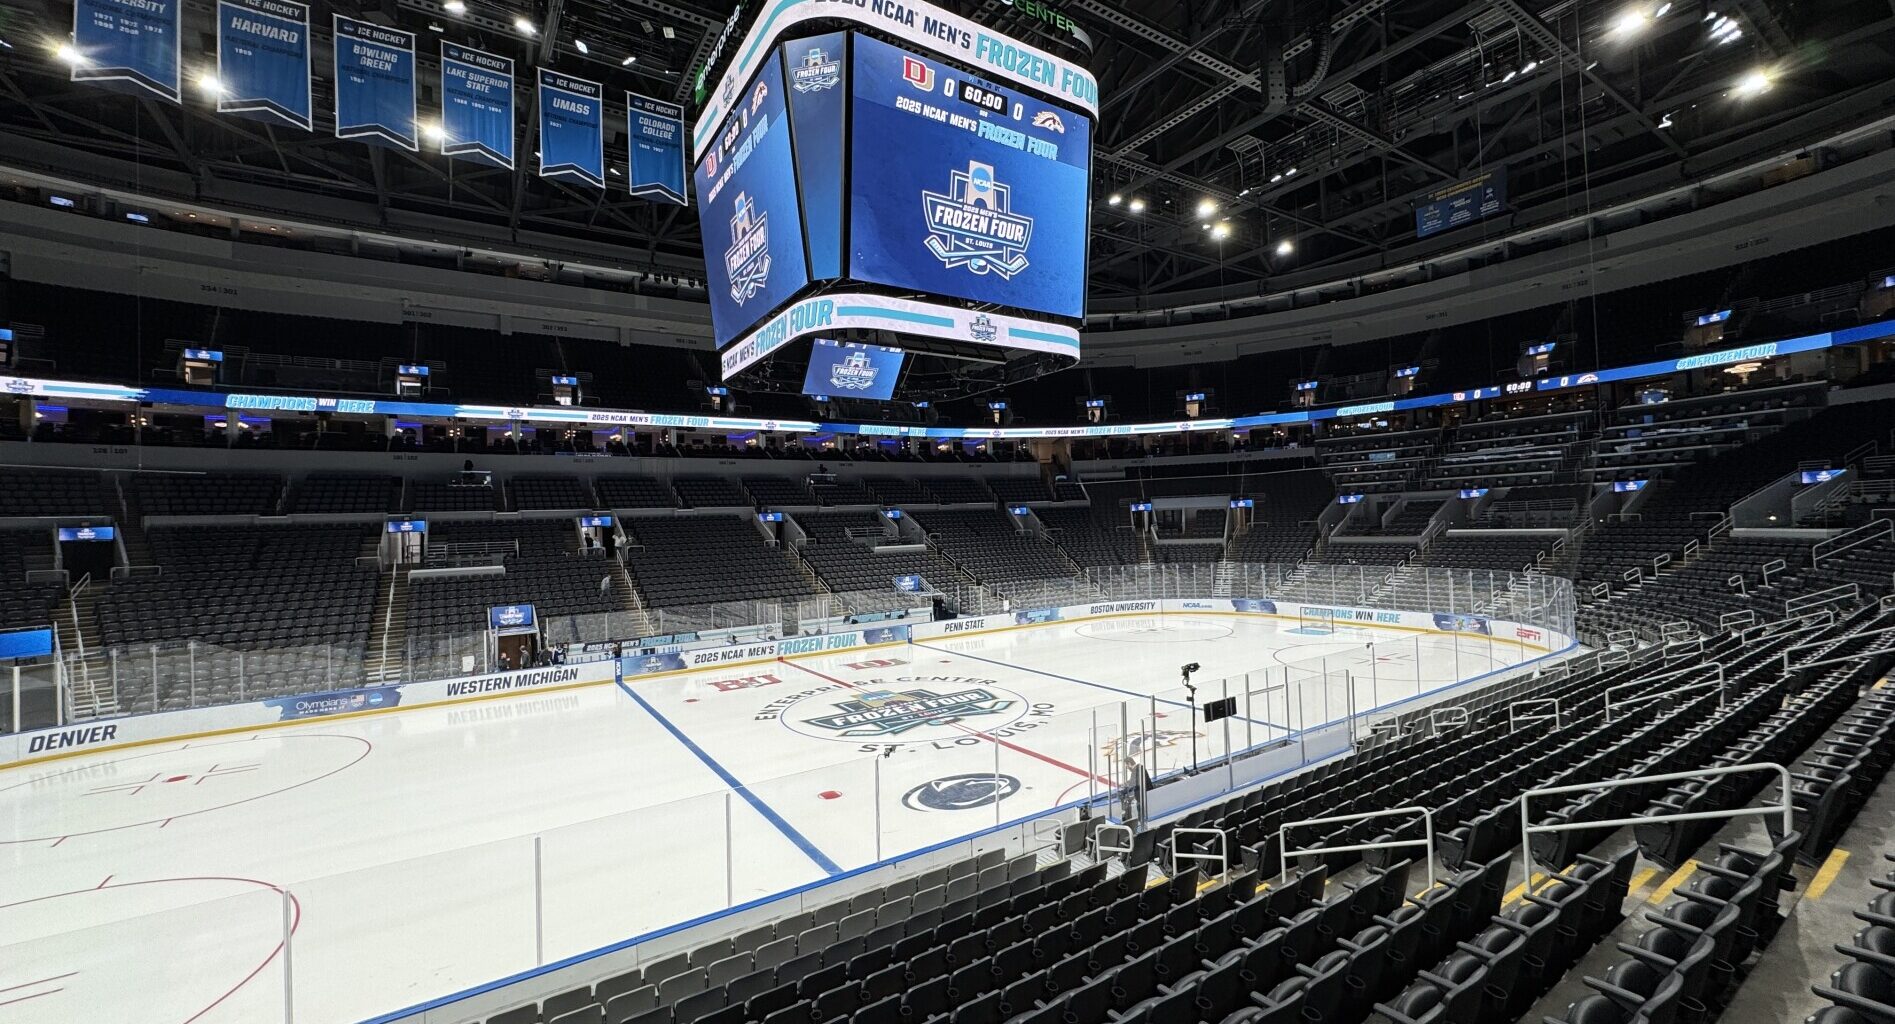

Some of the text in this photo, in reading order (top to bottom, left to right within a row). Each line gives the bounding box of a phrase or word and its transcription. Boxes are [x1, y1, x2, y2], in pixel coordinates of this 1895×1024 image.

[263, 1, 300, 17] HOCKEY
[232, 16, 299, 44] HARVARD
[358, 27, 371, 37] ICE
[373, 30, 406, 45] HOCKEY
[923, 15, 972, 50] MEN'S
[353, 44, 398, 63] BOWLING
[695, 5, 740, 91] enterprise
[360, 57, 392, 71] GREEN
[462, 51, 506, 70] ICE HOCKEY
[976, 31, 1098, 107] FROZEN FOU
[446, 66, 509, 89] LAKE SUPERIOR
[466, 80, 491, 94] STATE
[556, 78, 596, 94] ICE HOCKEY
[553, 97, 590, 115] UMASS
[944, 78, 955, 97] 0
[964, 86, 1003, 110] 60:00
[1013, 103, 1023, 121] 0
[644, 102, 678, 117] ICE HOCKEY
[639, 116, 676, 132] COLORADO
[642, 126, 673, 140] COLLEGE
[896, 96, 921, 114] 2025
[949, 113, 977, 132] MEN'S
[978, 119, 1026, 150] FROZEN
[1026, 135, 1059, 161] FOUR
[973, 177, 991, 189] NCAA
[980, 208, 998, 218] MEN'S
[935, 205, 1024, 242] FROZEN FOUR
[965, 237, 993, 249] ST. LOUIS
[756, 318, 787, 356] FROZEN
[790, 300, 833, 336] FOUR
[1676, 343, 1776, 370] #MFROZENFOUR
[1474, 390, 1481, 398] 0
[1506, 382, 1531, 391] 60:00
[1561, 376, 1568, 387] 0
[226, 394, 375, 413] CHAMPIONS WIN HERE
[650, 416, 684, 425] FROZEN
[687, 417, 709, 426] FOUR
[1090, 601, 1155, 614] BOSTON UNIVERSITY
[1355, 610, 1373, 620] WIN
[1376, 612, 1401, 623] HERE
[945, 619, 985, 632] PENN STATE
[1517, 627, 1541, 641] ESPN
[695, 652, 718, 664] 2025
[748, 645, 774, 657] MEN'S
[777, 637, 823, 655] FROZEN
[827, 633, 857, 650] FOUR
[447, 668, 578, 696] WESTERN MICHIGAN
[296, 698, 348, 711] Olympians
[754, 676, 997, 721] ENTERPRISE CENTER
[832, 703, 922, 726] FROZEN
[927, 693, 984, 708] FOUR
[858, 743, 917, 753] ST.
[1033, 702, 1055, 717] MO
[29, 724, 117, 753] DENVER
